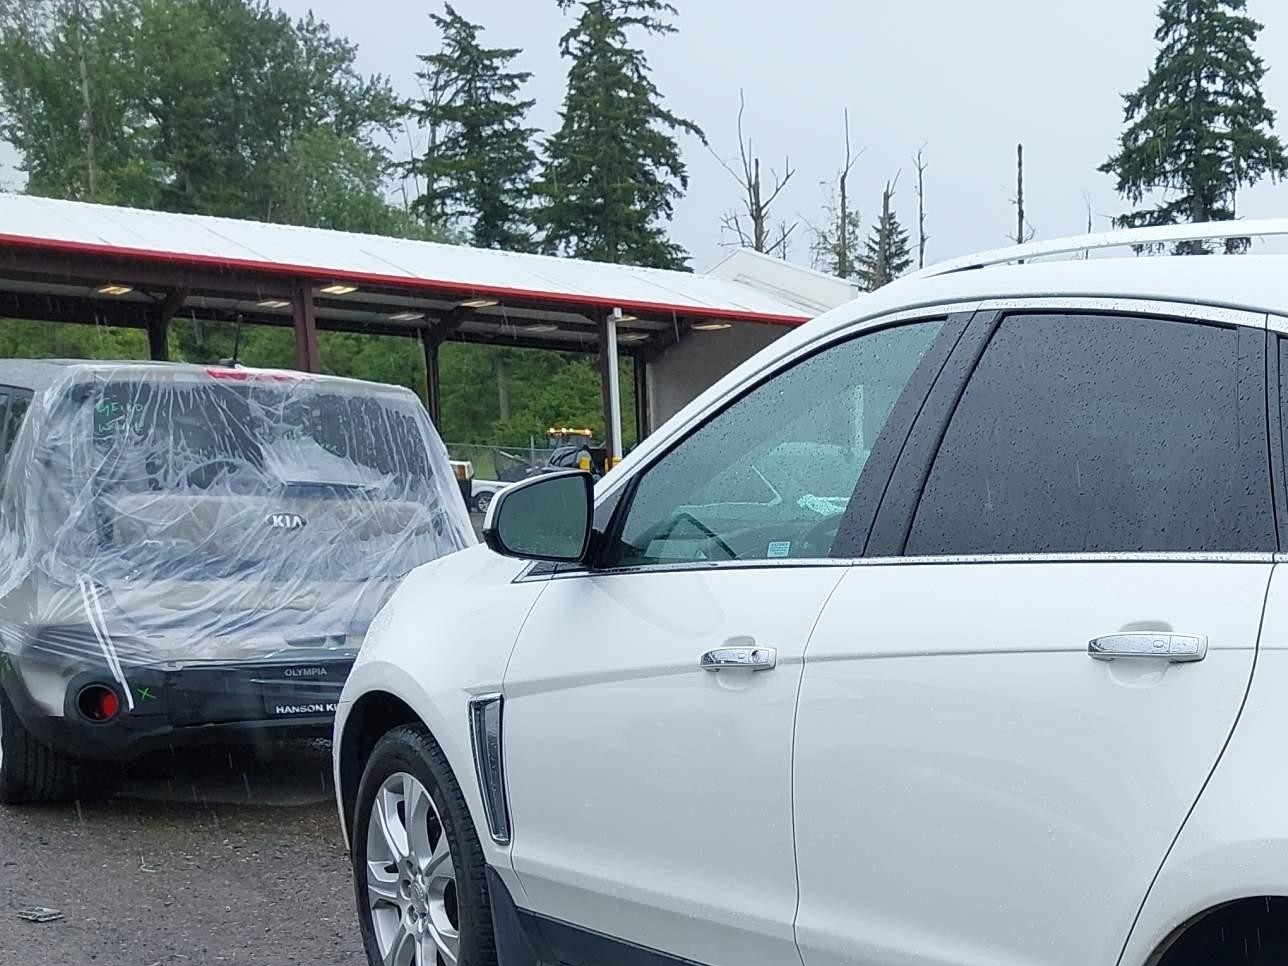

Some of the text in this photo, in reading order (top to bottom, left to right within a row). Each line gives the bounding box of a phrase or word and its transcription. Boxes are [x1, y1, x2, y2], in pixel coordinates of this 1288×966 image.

[272, 515, 303, 528] KIA
[284, 667, 327, 677] OLYMPIA
[275, 704, 324, 714] HANSON
